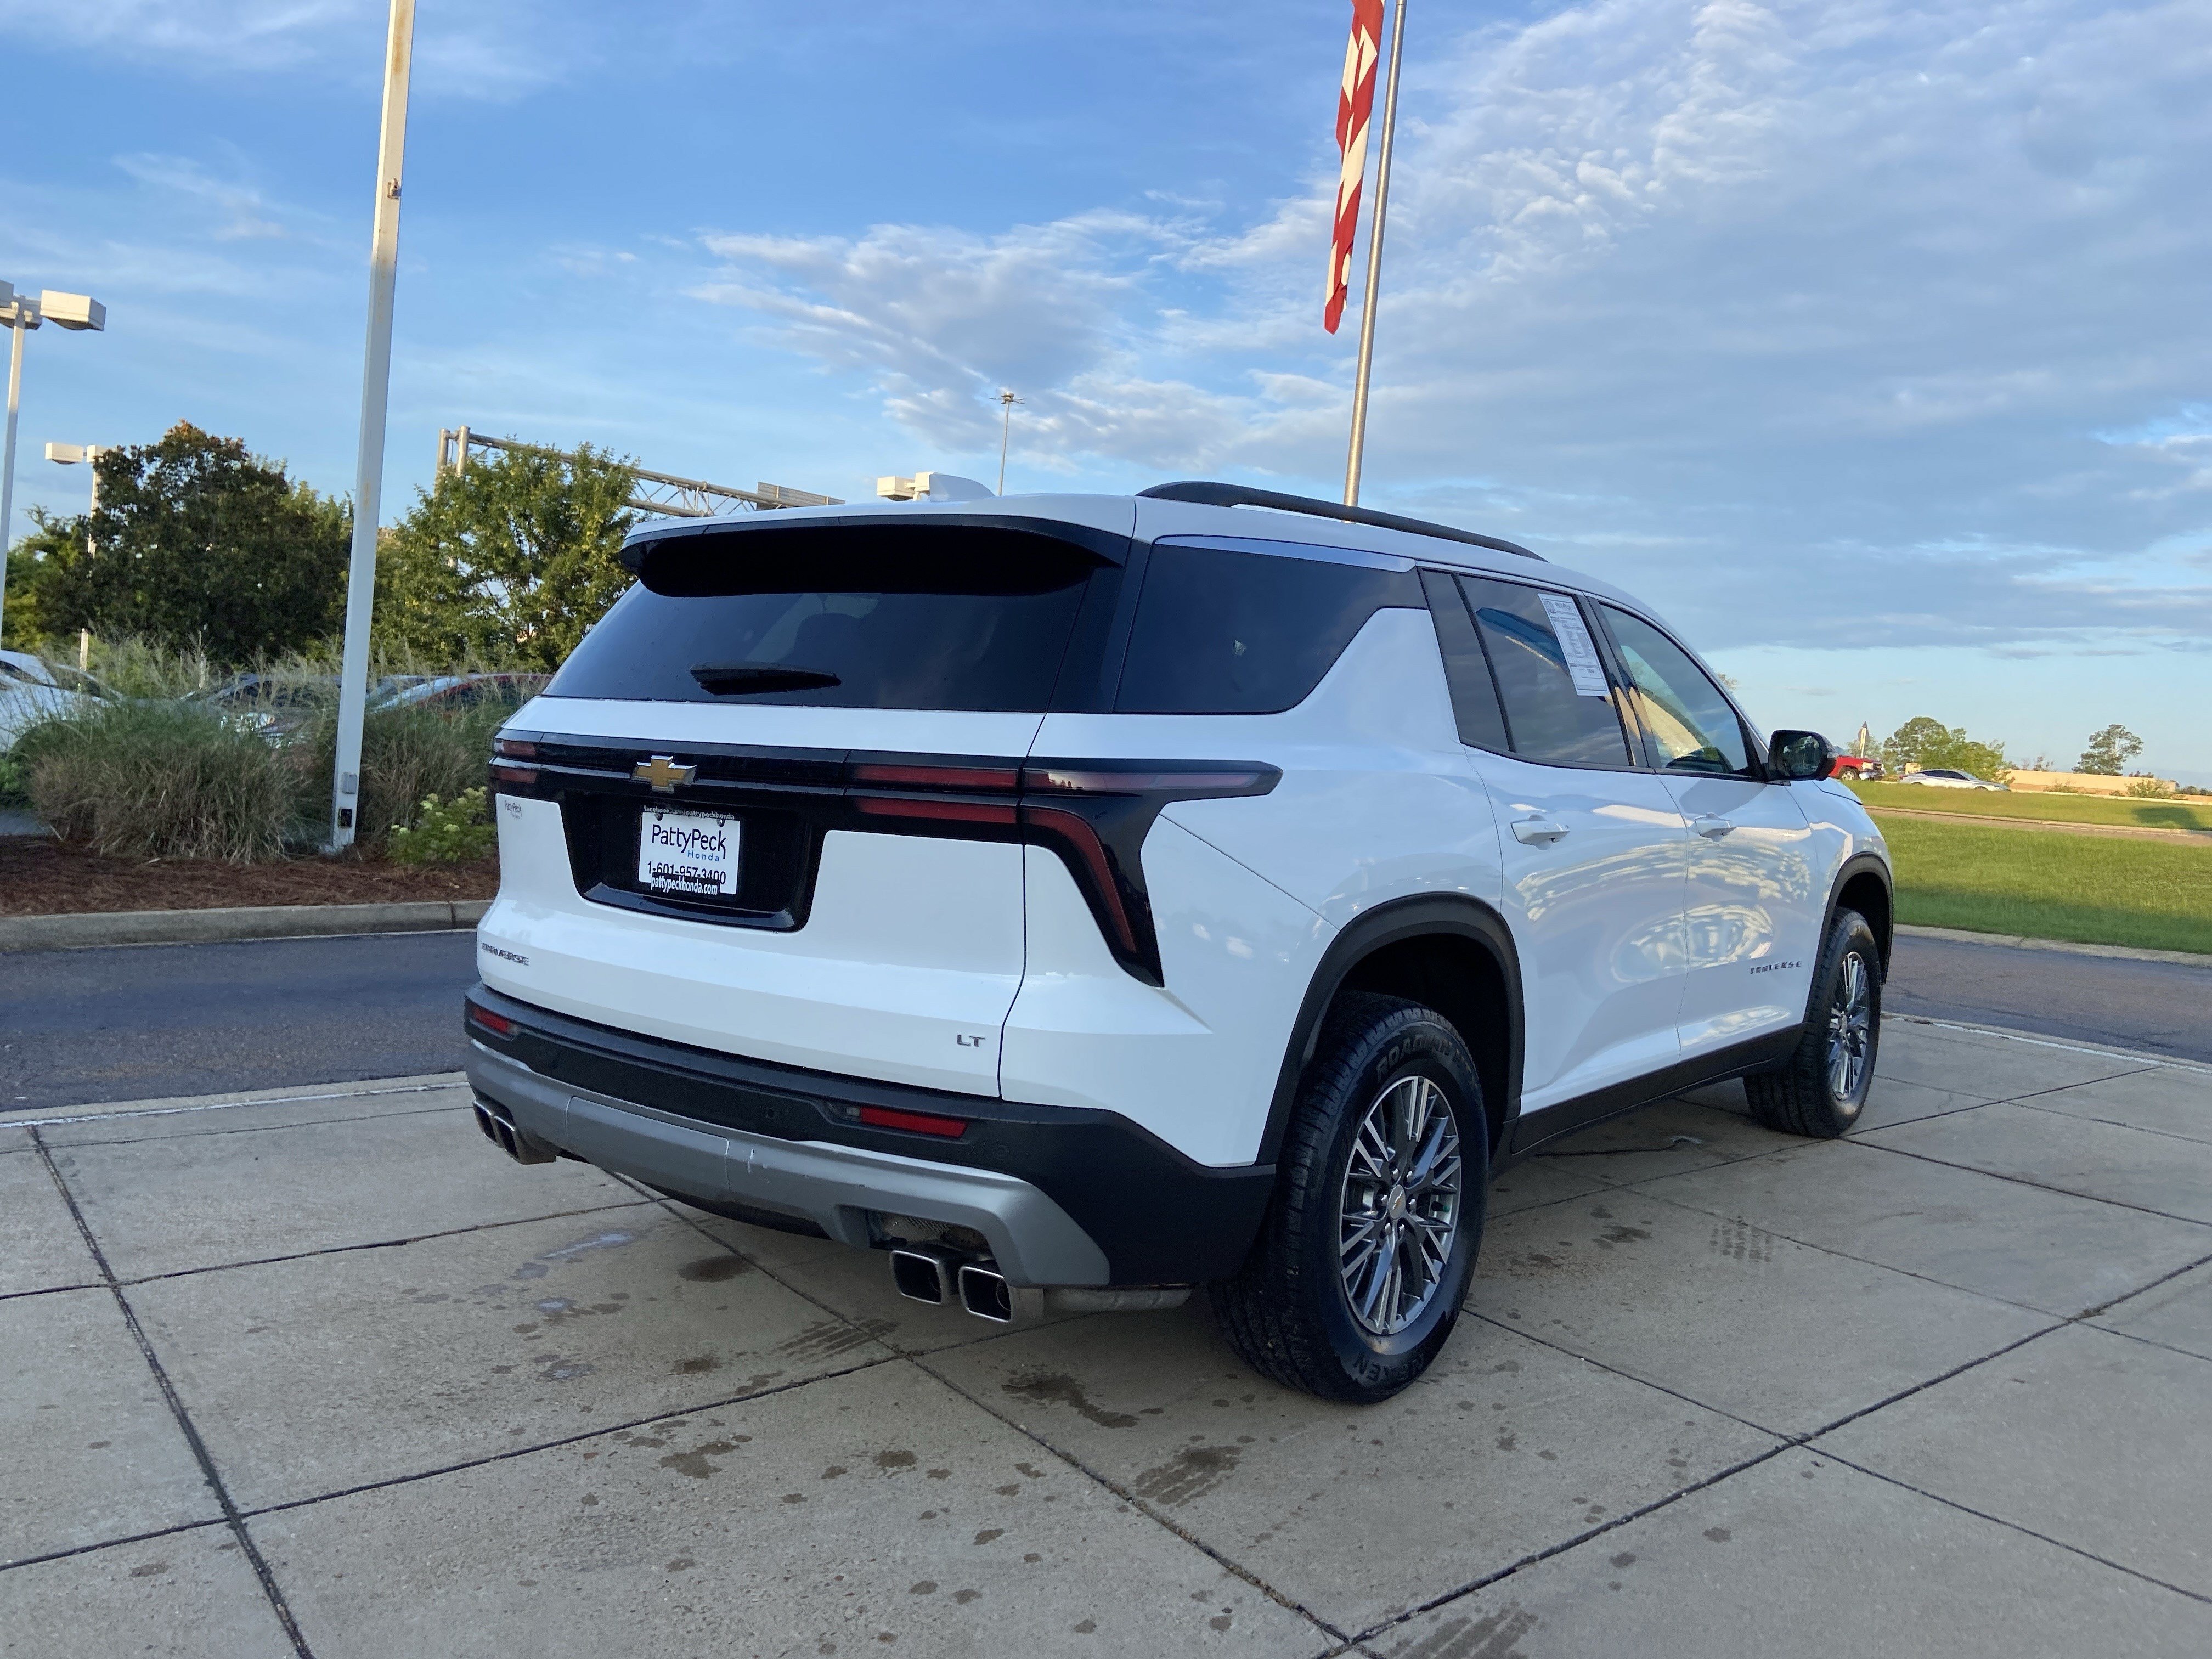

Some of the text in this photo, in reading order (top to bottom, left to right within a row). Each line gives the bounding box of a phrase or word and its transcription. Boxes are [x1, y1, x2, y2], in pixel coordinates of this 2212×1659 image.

[652, 824, 727, 860] PattyPeck
[687, 850, 720, 862] Honda
[647, 861, 726, 885] 1-601-957-3400
[651, 876, 718, 895] pattypeckhonda.com
[957, 1034, 985, 1047] LT
